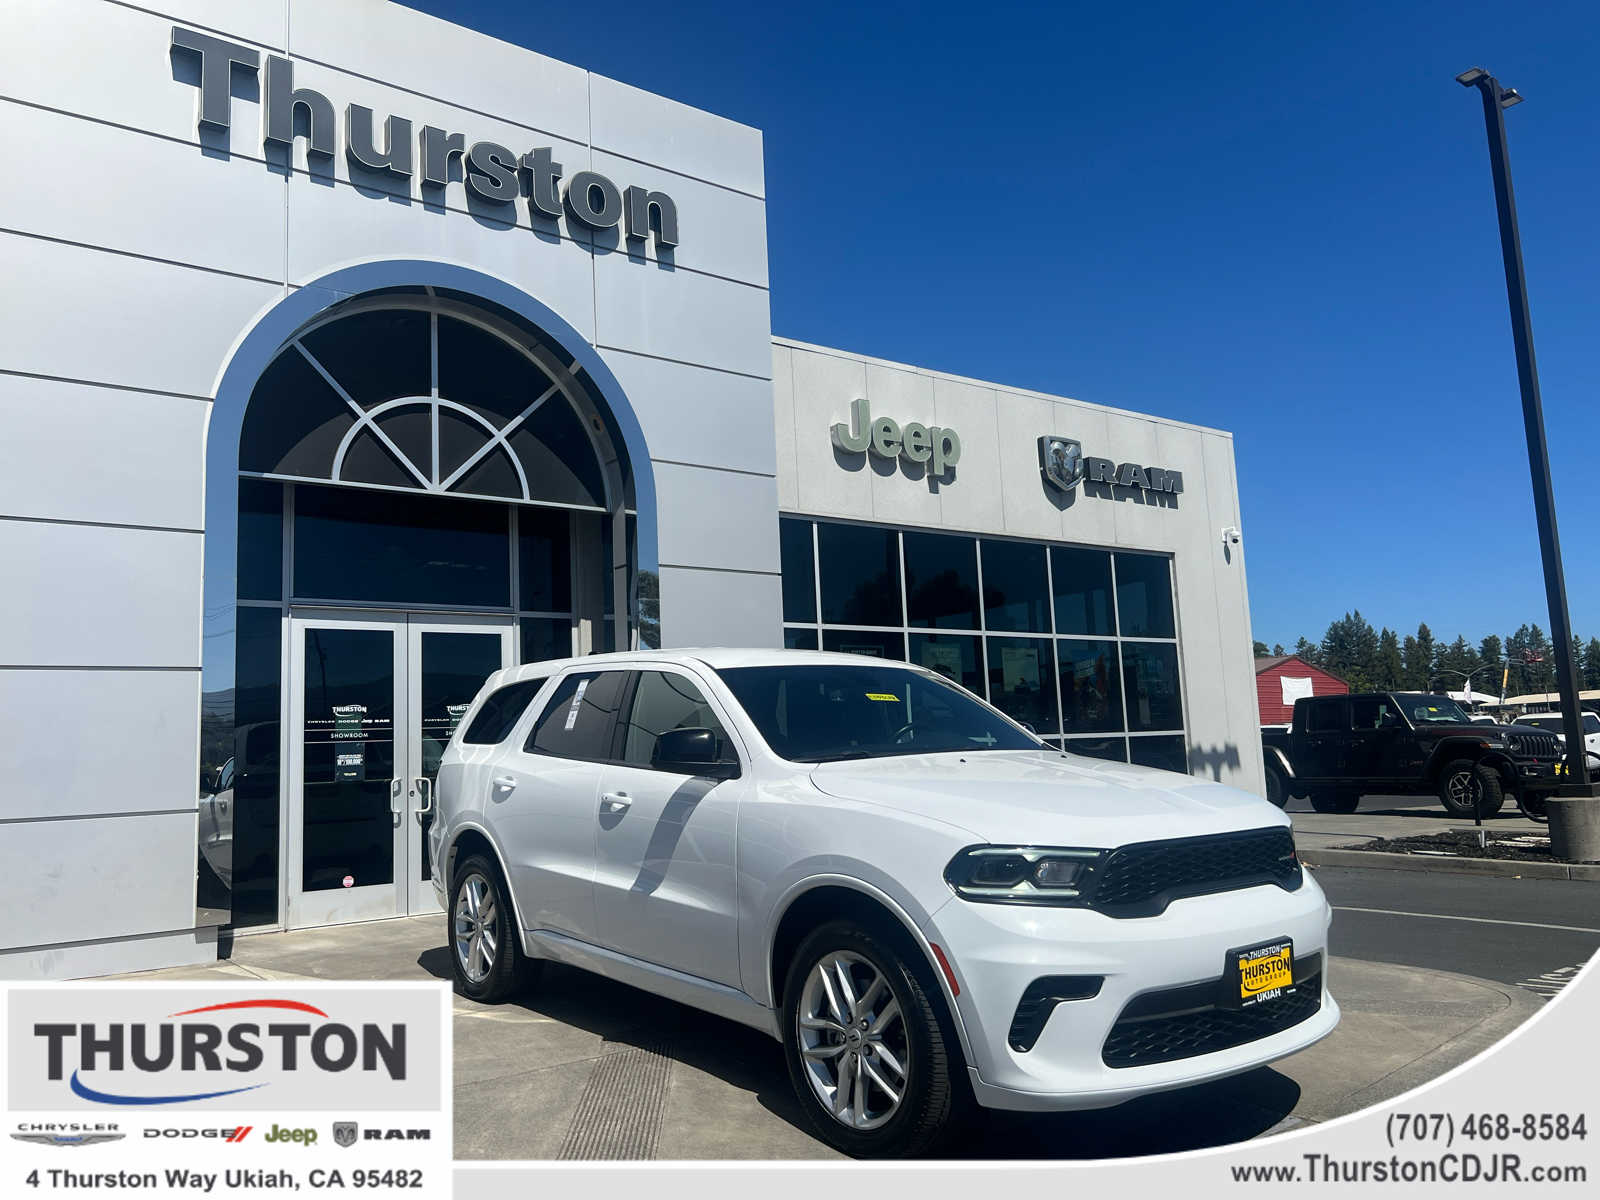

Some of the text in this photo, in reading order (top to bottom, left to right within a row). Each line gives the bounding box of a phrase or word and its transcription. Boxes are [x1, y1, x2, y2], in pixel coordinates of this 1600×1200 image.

[171, 26, 679, 248] Thurston
[831, 399, 961, 477] Jeep
[1083, 456, 1184, 494] RAM
[332, 705, 367, 713] THURSTON
[446, 705, 471, 713] THURST
[1250, 945, 1281, 959] THURSTON
[1240, 957, 1291, 984] THURSTON
[1257, 988, 1281, 1002] UKIAH
